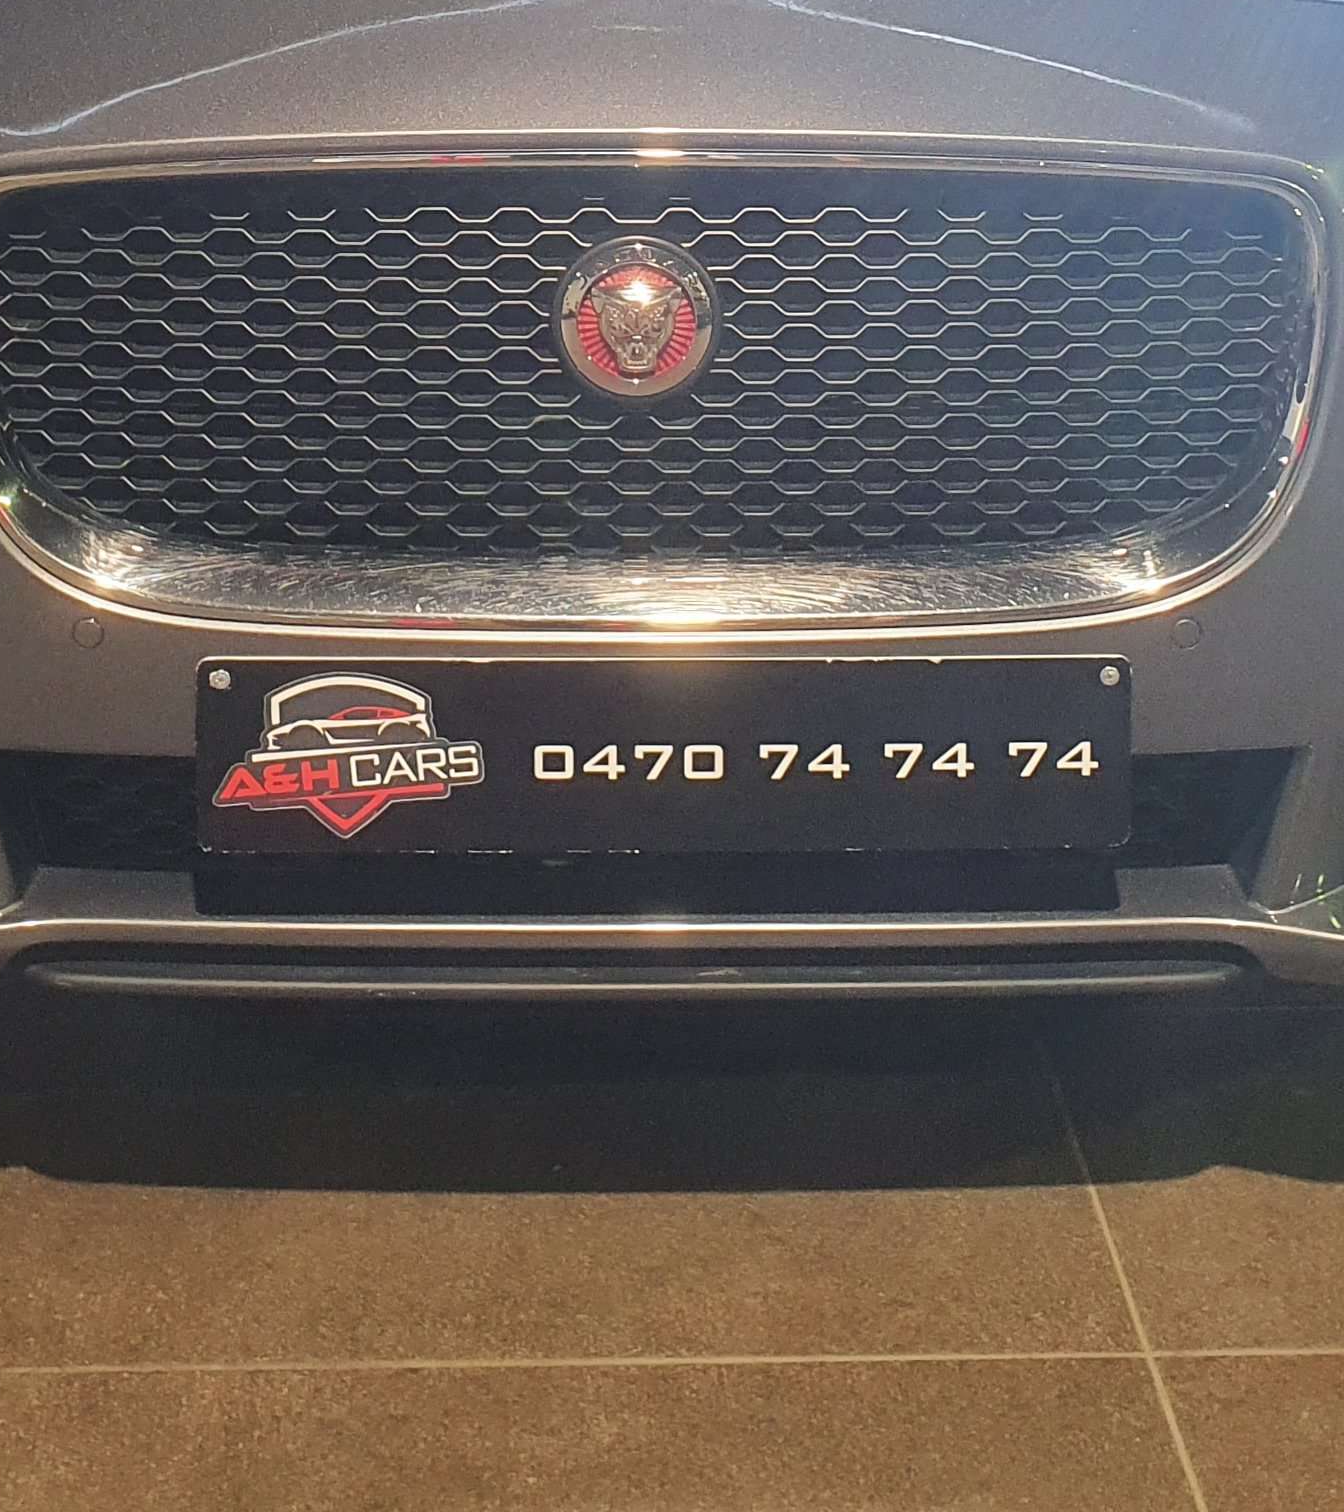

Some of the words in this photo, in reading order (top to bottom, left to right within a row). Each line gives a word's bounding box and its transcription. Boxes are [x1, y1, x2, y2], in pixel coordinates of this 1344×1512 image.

[219, 759, 340, 800] A&H
[350, 745, 479, 787] CARS
[533, 744, 724, 781] 0470
[759, 744, 851, 781] 74
[883, 742, 975, 780] 74
[1007, 741, 1099, 779] 74
